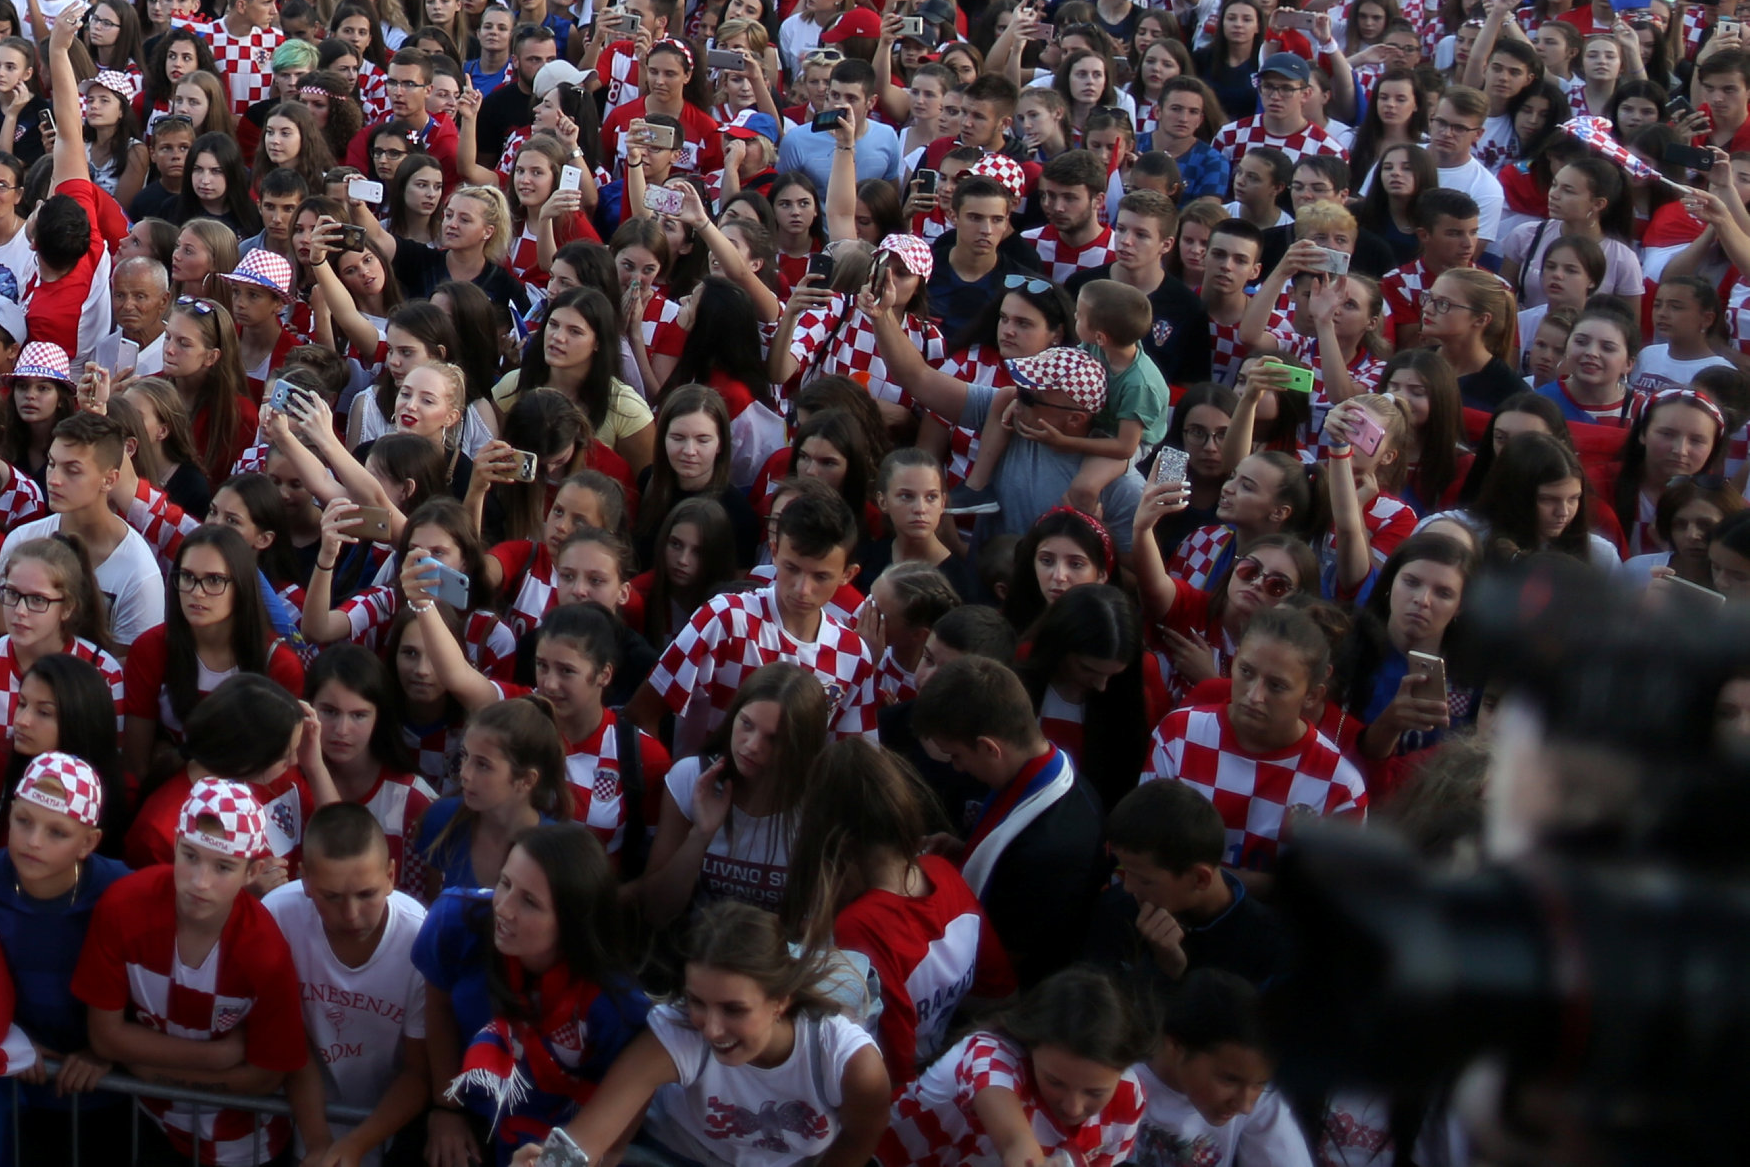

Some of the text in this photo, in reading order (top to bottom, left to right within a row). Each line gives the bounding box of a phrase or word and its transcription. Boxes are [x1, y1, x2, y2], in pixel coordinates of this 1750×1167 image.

[16, 366, 55, 376] CROATIA
[32, 791, 60, 807] CROATIA
[200, 833, 228, 851] CROATIA
[703, 858, 761, 883] LIVNO
[916, 959, 975, 1023] RAKIT
[298, 981, 404, 1025] ZNESENJE
